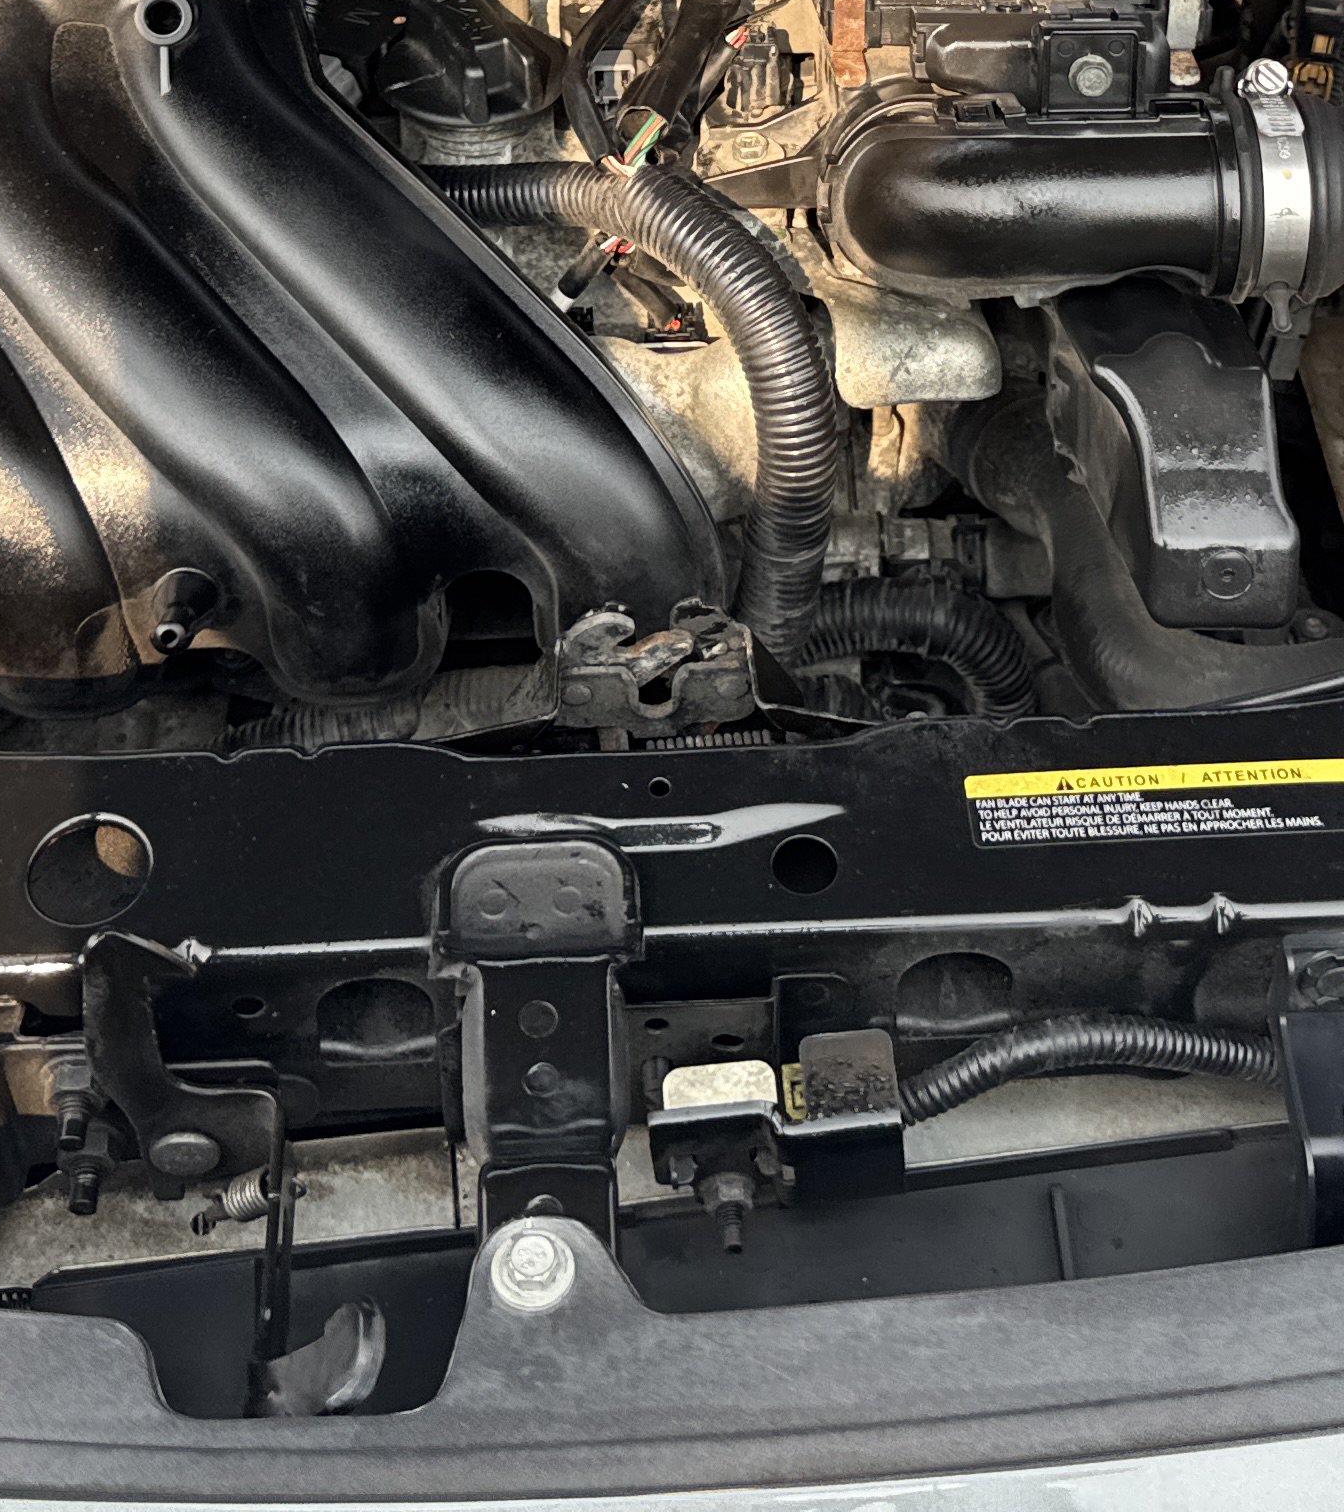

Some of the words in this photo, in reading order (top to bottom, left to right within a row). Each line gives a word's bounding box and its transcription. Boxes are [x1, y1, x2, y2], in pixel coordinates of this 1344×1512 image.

[1075, 774, 1160, 789] CAUTION
[1181, 772, 1186, 784] /
[1202, 767, 1302, 783] ATTENTION
[976, 799, 996, 809] FAN
[997, 797, 1028, 808] BLADE
[1029, 796, 1052, 807] CAN
[1052, 794, 1081, 806] START
[1082, 794, 1095, 804] AT
[1096, 793, 1117, 804] ANY
[1117, 792, 1144, 803] TIME.
[979, 810, 993, 820] TO
[994, 808, 1018, 819] HELP
[1020, 806, 1051, 818] AVOID
[1052, 804, 1102, 816] PERSONAL
[1140, 801, 1164, 812] KEEP
[1164, 799, 1199, 811] HANDS
[1201, 797, 1234, 809] CLEAR.
[979, 821, 992, 831] LE
[993, 817, 1064, 830] VENTILATEUR
[1065, 815, 1105, 826] RISQUE
[1106, 814, 1121, 824] DE
[1123, 810, 1181, 824] DÉMARRER
[1182, 807, 1191, 820] À
[1191, 809, 1221, 820] TOUT
[1222, 806, 1275, 819] MOMENT.
[981, 830, 1013, 842] POUR
[1014, 826, 1050, 840] ÉVITER
[1050, 825, 1087, 838] TOUTE
[1087, 824, 1144, 837] BLESSURE,
[1144, 823, 1160, 834] NE
[1161, 822, 1182, 833] PAS
[1182, 821, 1198, 832] EN
[1199, 818, 1264, 831] APPROCHER
[1265, 817, 1284, 828] LES
[1285, 815, 1325, 828] MAINS.
